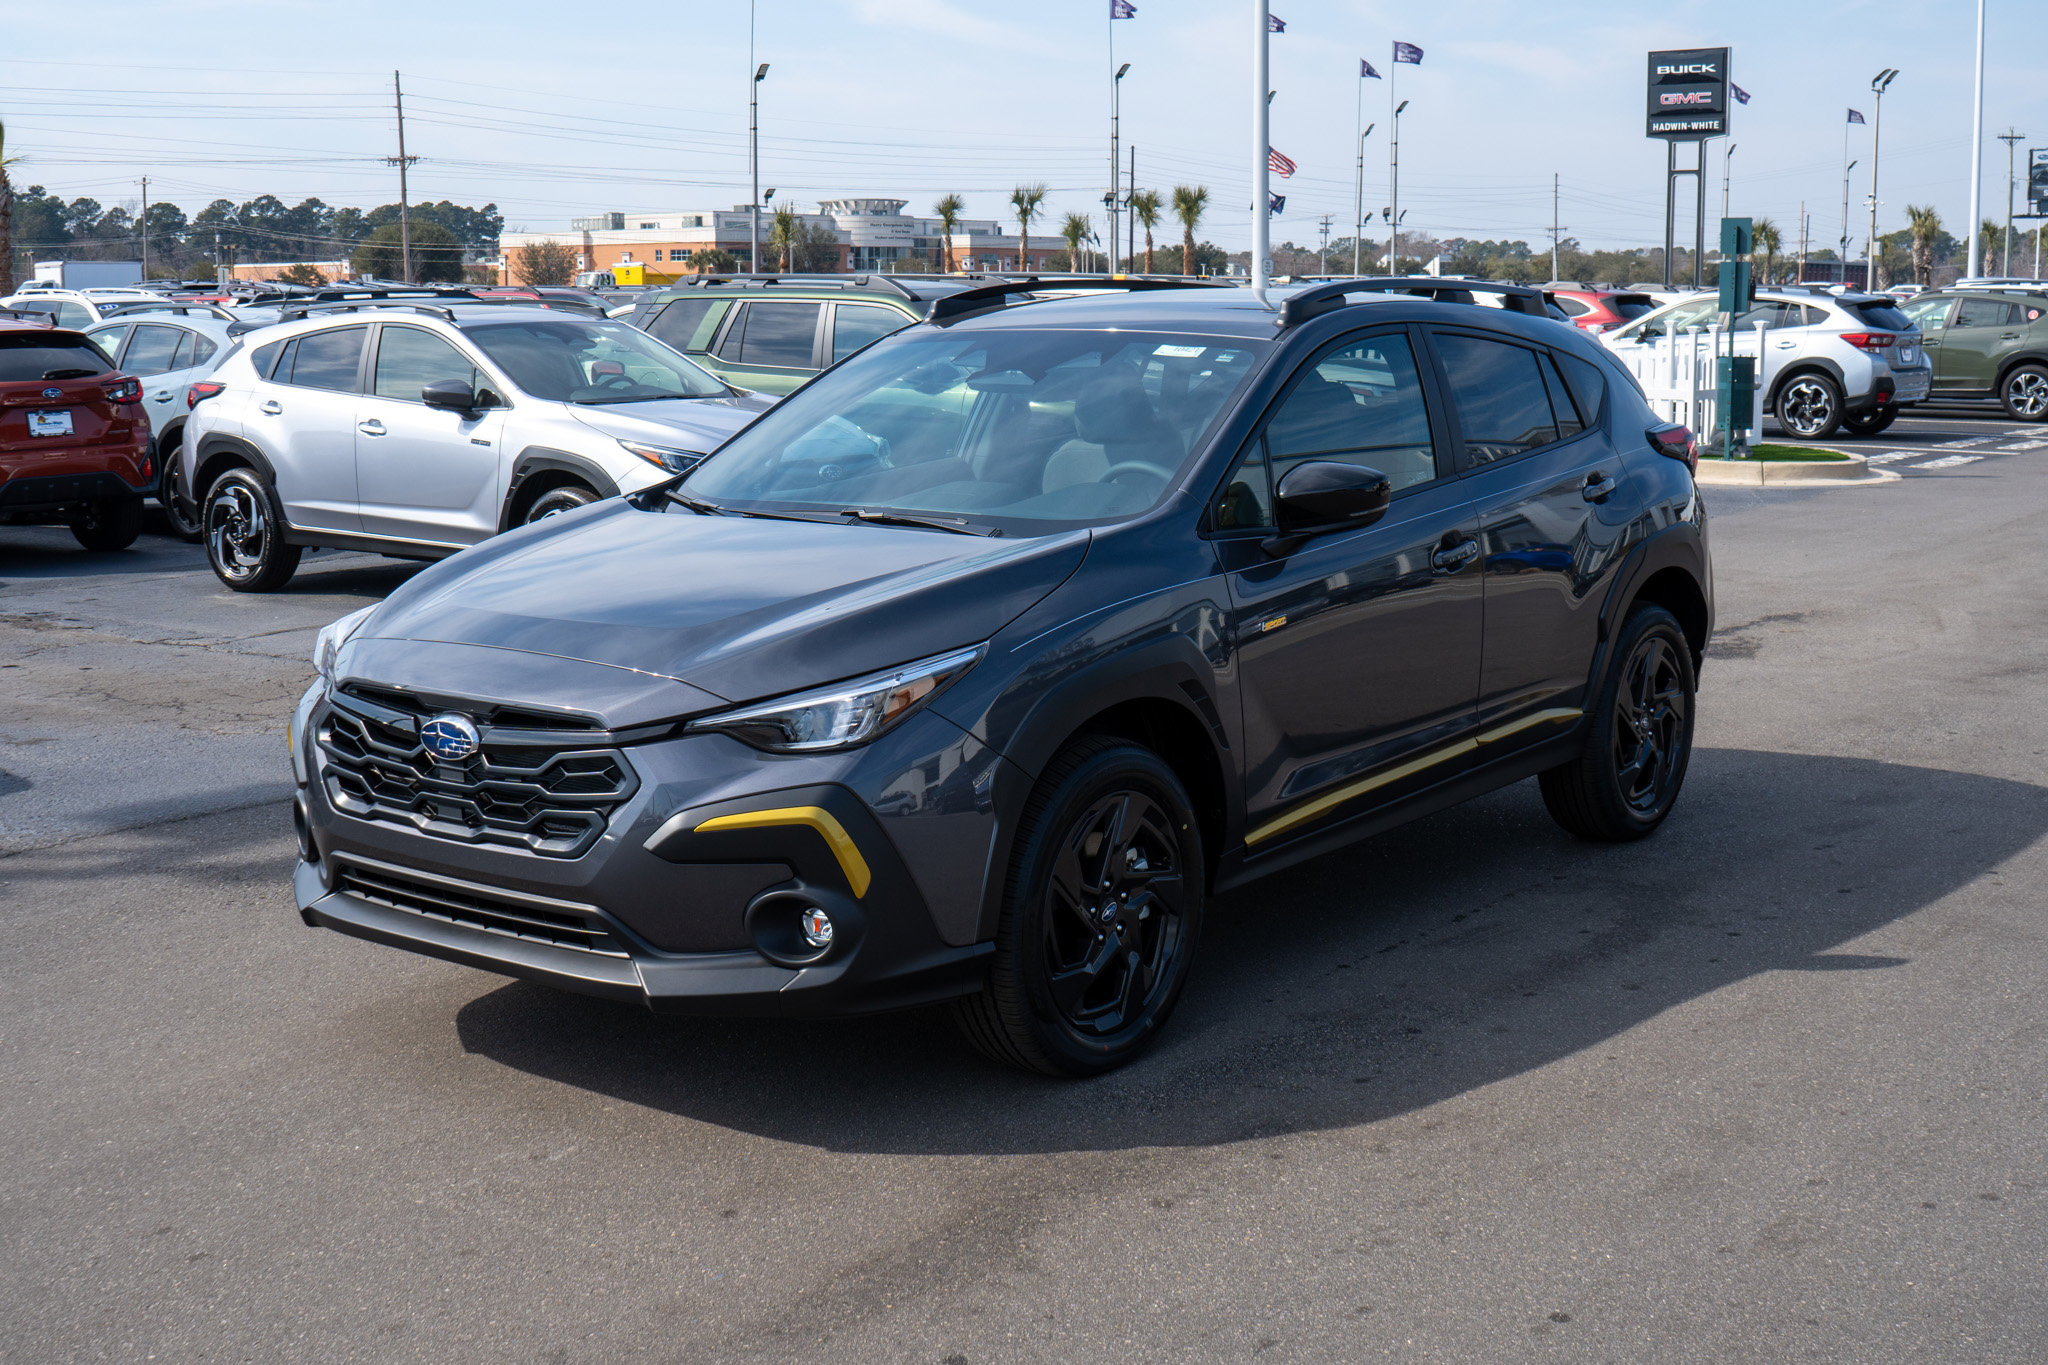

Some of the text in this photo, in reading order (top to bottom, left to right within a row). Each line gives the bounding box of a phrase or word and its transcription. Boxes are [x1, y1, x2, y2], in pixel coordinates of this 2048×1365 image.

[1656, 64, 1716, 74] BUICK
[1660, 91, 1712, 105] GMC
[1652, 120, 1720, 131] HADWIN-WHITE
